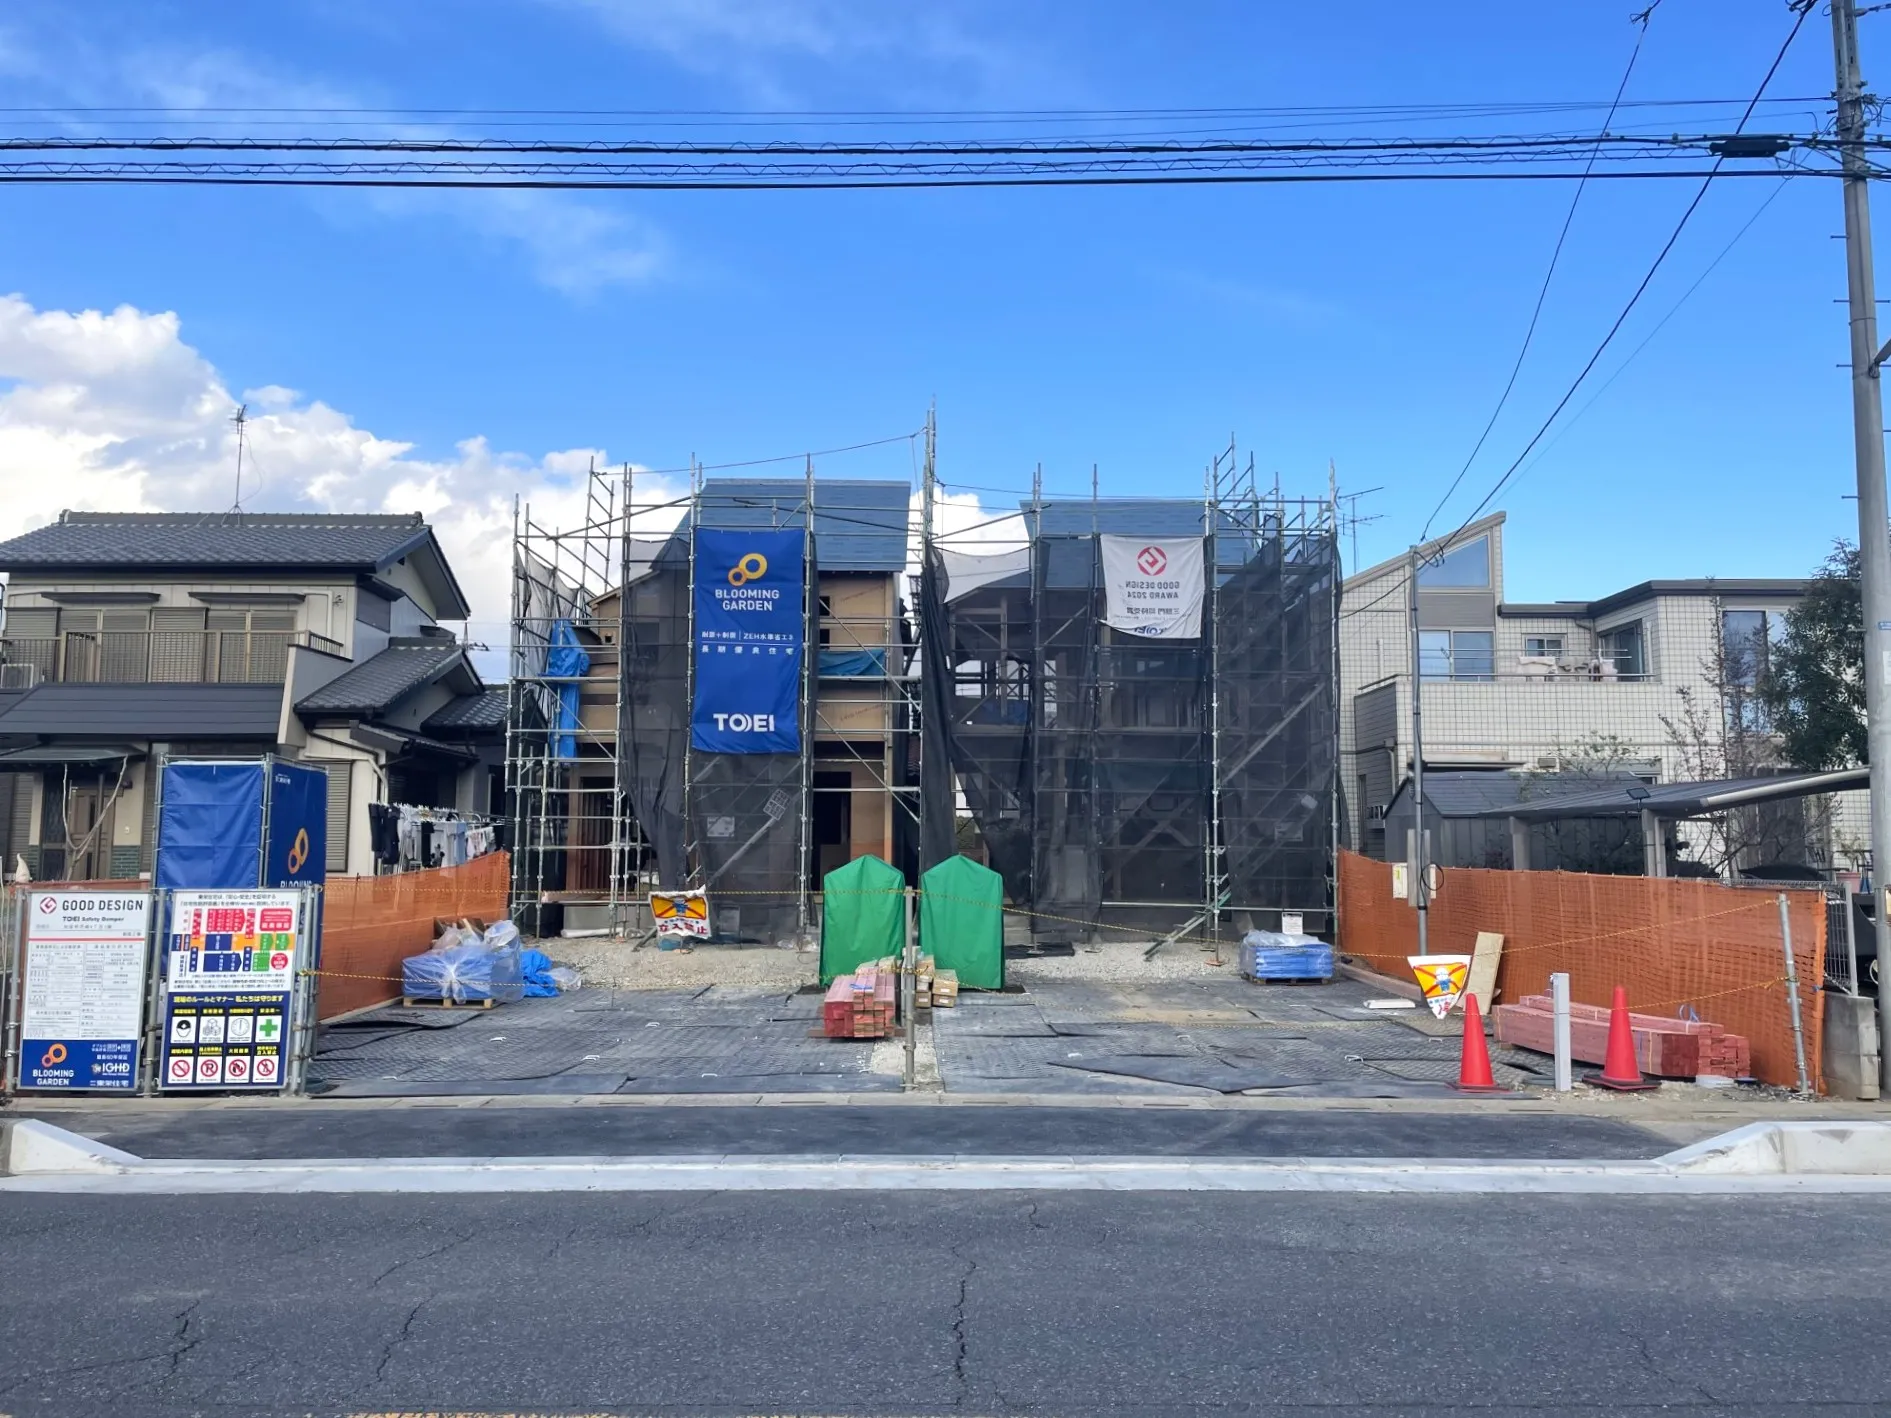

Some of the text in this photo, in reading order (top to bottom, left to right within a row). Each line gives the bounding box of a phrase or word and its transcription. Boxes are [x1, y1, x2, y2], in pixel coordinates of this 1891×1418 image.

[715, 589, 780, 599] BLOOMING
[722, 601, 773, 611] GARDEN
[702, 645, 794, 655] 長期優良住宅
[62, 900, 143, 910] GOOD DESIGN
[102, 1062, 130, 1072] IGHD
[32, 1069, 74, 1078] BLOOMING
[36, 1078, 70, 1086] GARDEN
